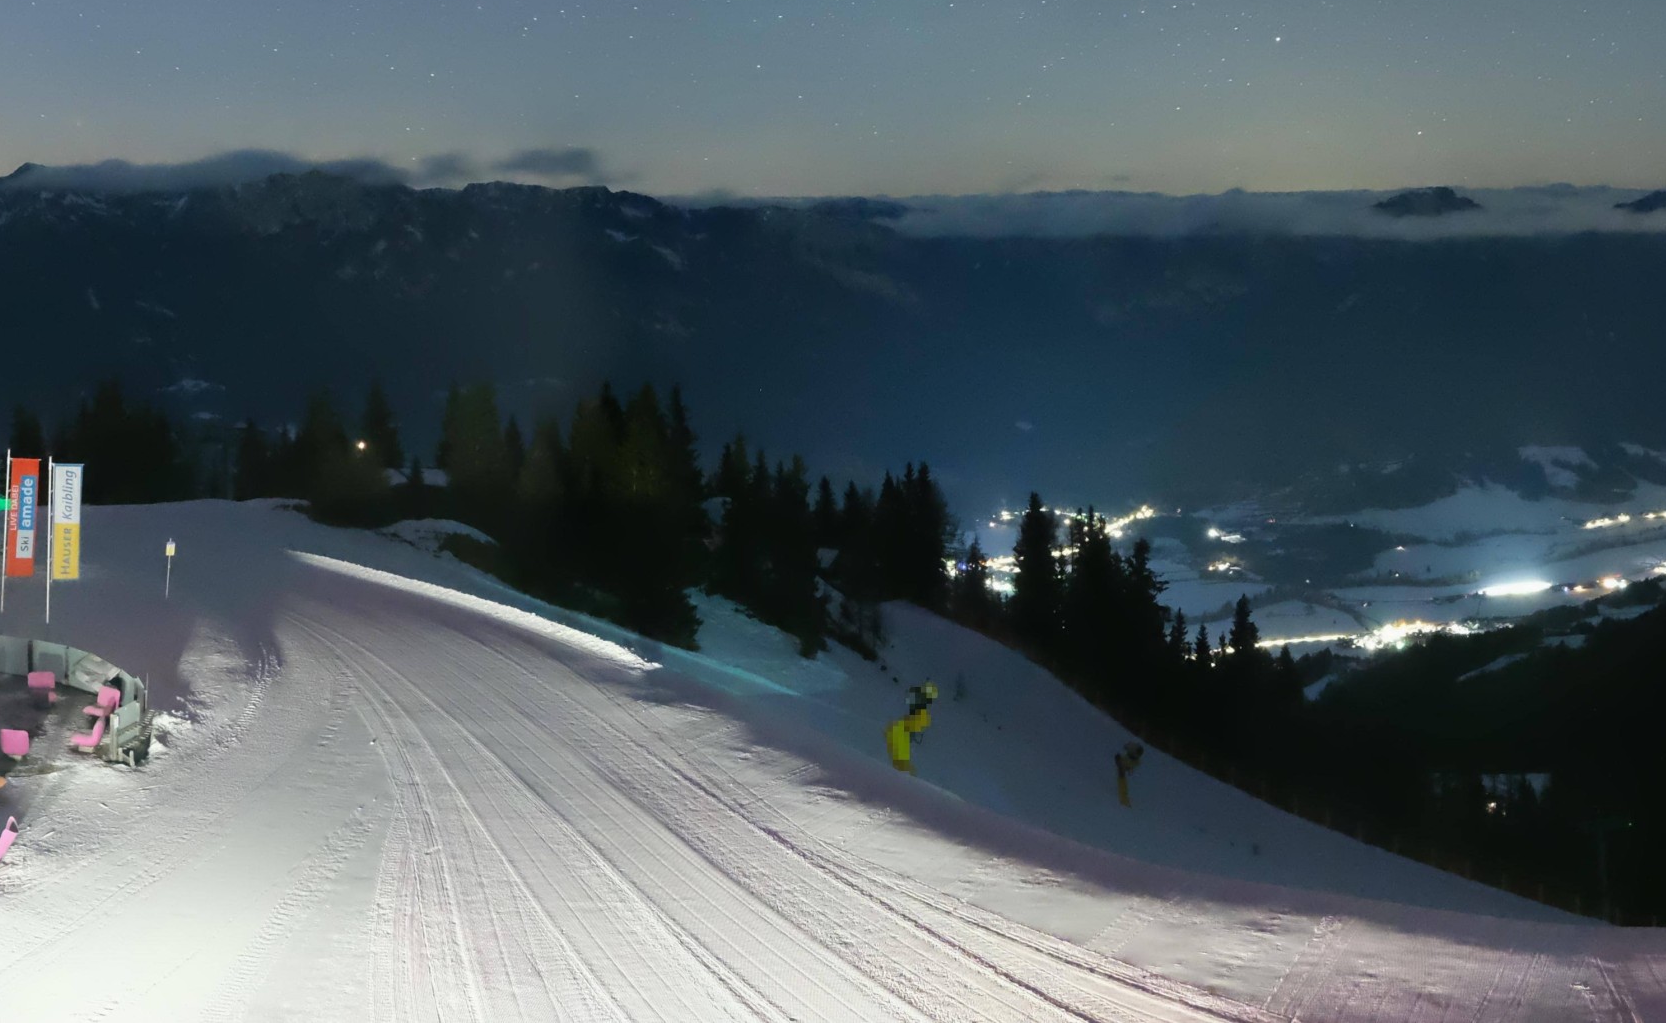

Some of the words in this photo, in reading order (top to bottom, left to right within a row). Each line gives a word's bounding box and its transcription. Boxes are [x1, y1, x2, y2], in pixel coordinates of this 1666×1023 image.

[11, 485, 19, 510] DABEI
[61, 470, 77, 520] Kaibling
[9, 512, 18, 531] LIVE
[20, 536, 30, 552] Ski
[60, 528, 72, 575] HAUSER
